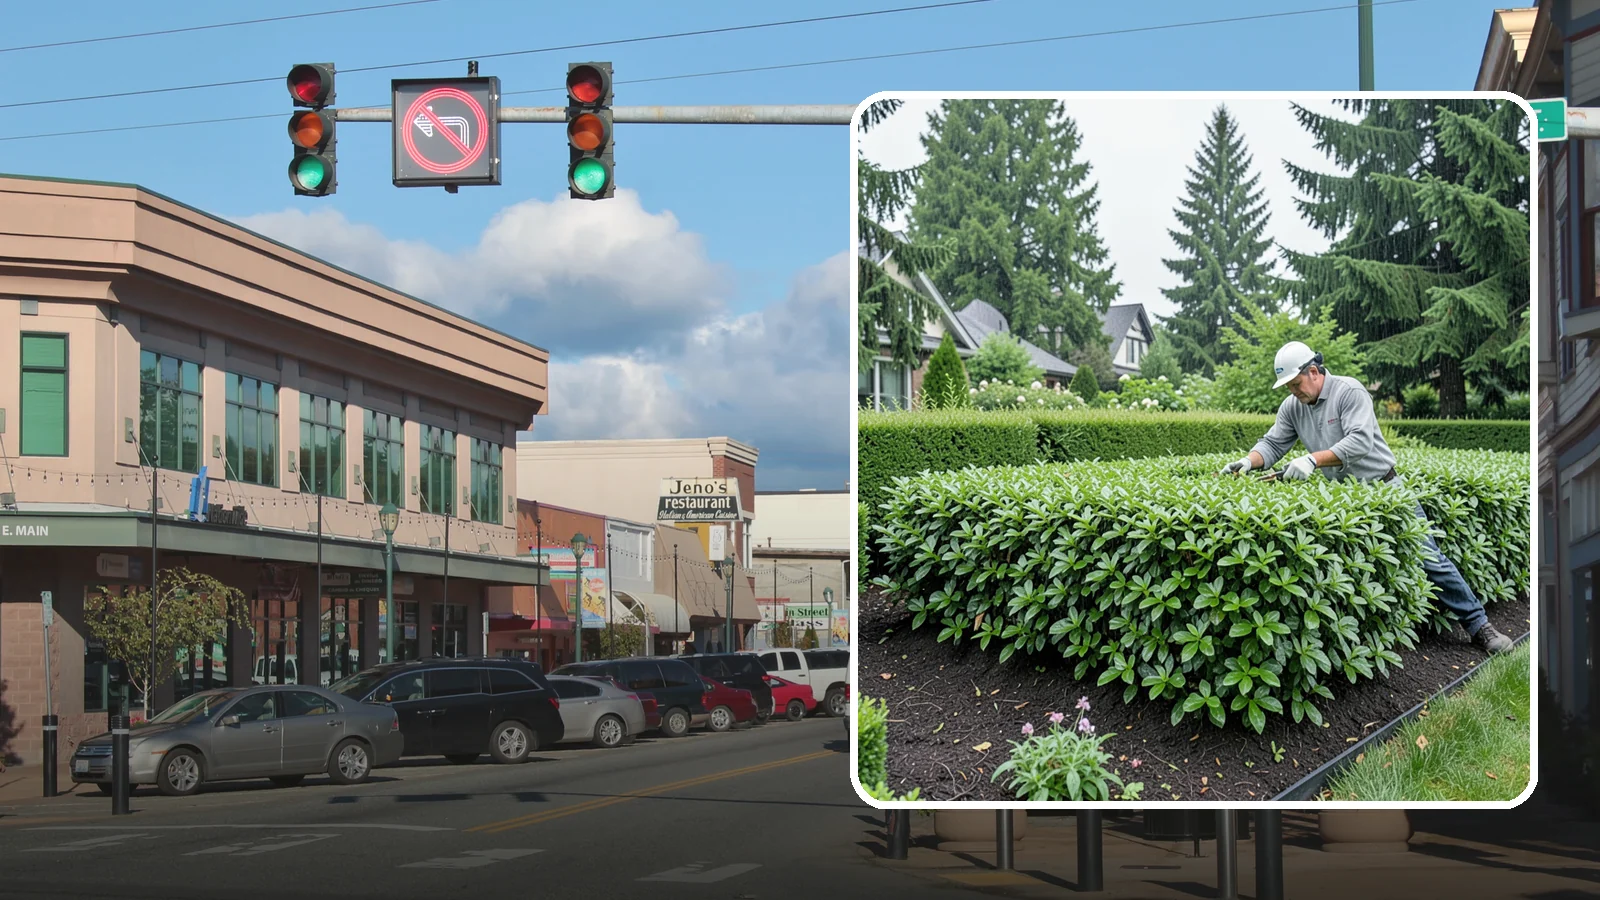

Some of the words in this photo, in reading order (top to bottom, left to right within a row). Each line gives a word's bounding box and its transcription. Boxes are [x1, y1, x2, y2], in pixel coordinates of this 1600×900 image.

[670, 480, 727, 494] Jeno's
[665, 496, 731, 509] restaurant
[686, 510, 714, 519] American
[715, 510, 736, 519] Cuisine
[2, 525, 13, 536] E.
[15, 525, 49, 536] MAIN
[796, 607, 828, 617] Street
